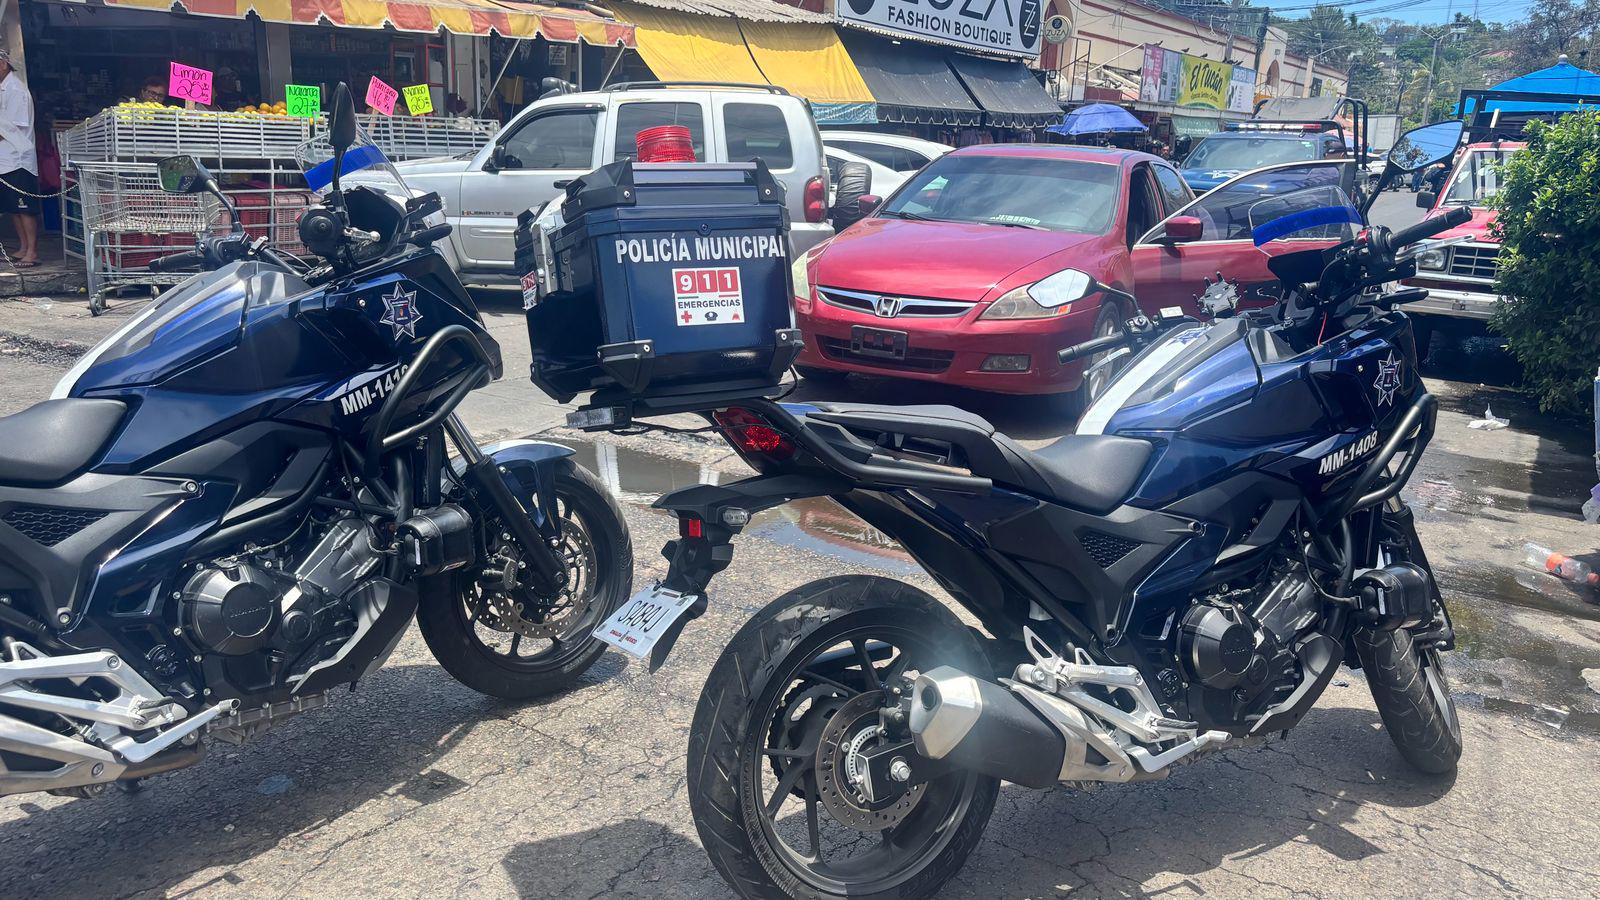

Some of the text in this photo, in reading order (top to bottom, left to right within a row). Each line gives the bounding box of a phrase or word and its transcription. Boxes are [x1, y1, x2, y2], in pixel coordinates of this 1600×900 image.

[888, 6, 951, 34] FASHION
[954, 21, 1012, 46] BOUTIQUE
[1190, 62, 1201, 92] El
[1200, 63, 1224, 95] Tucán
[615, 233, 786, 263] POLICÍA MUNICIPAL
[680, 273, 732, 291] 911
[678, 299, 741, 309] EMERGENCIAS
[1318, 430, 1378, 475] MM-1408
[617, 600, 671, 633] SA84J
